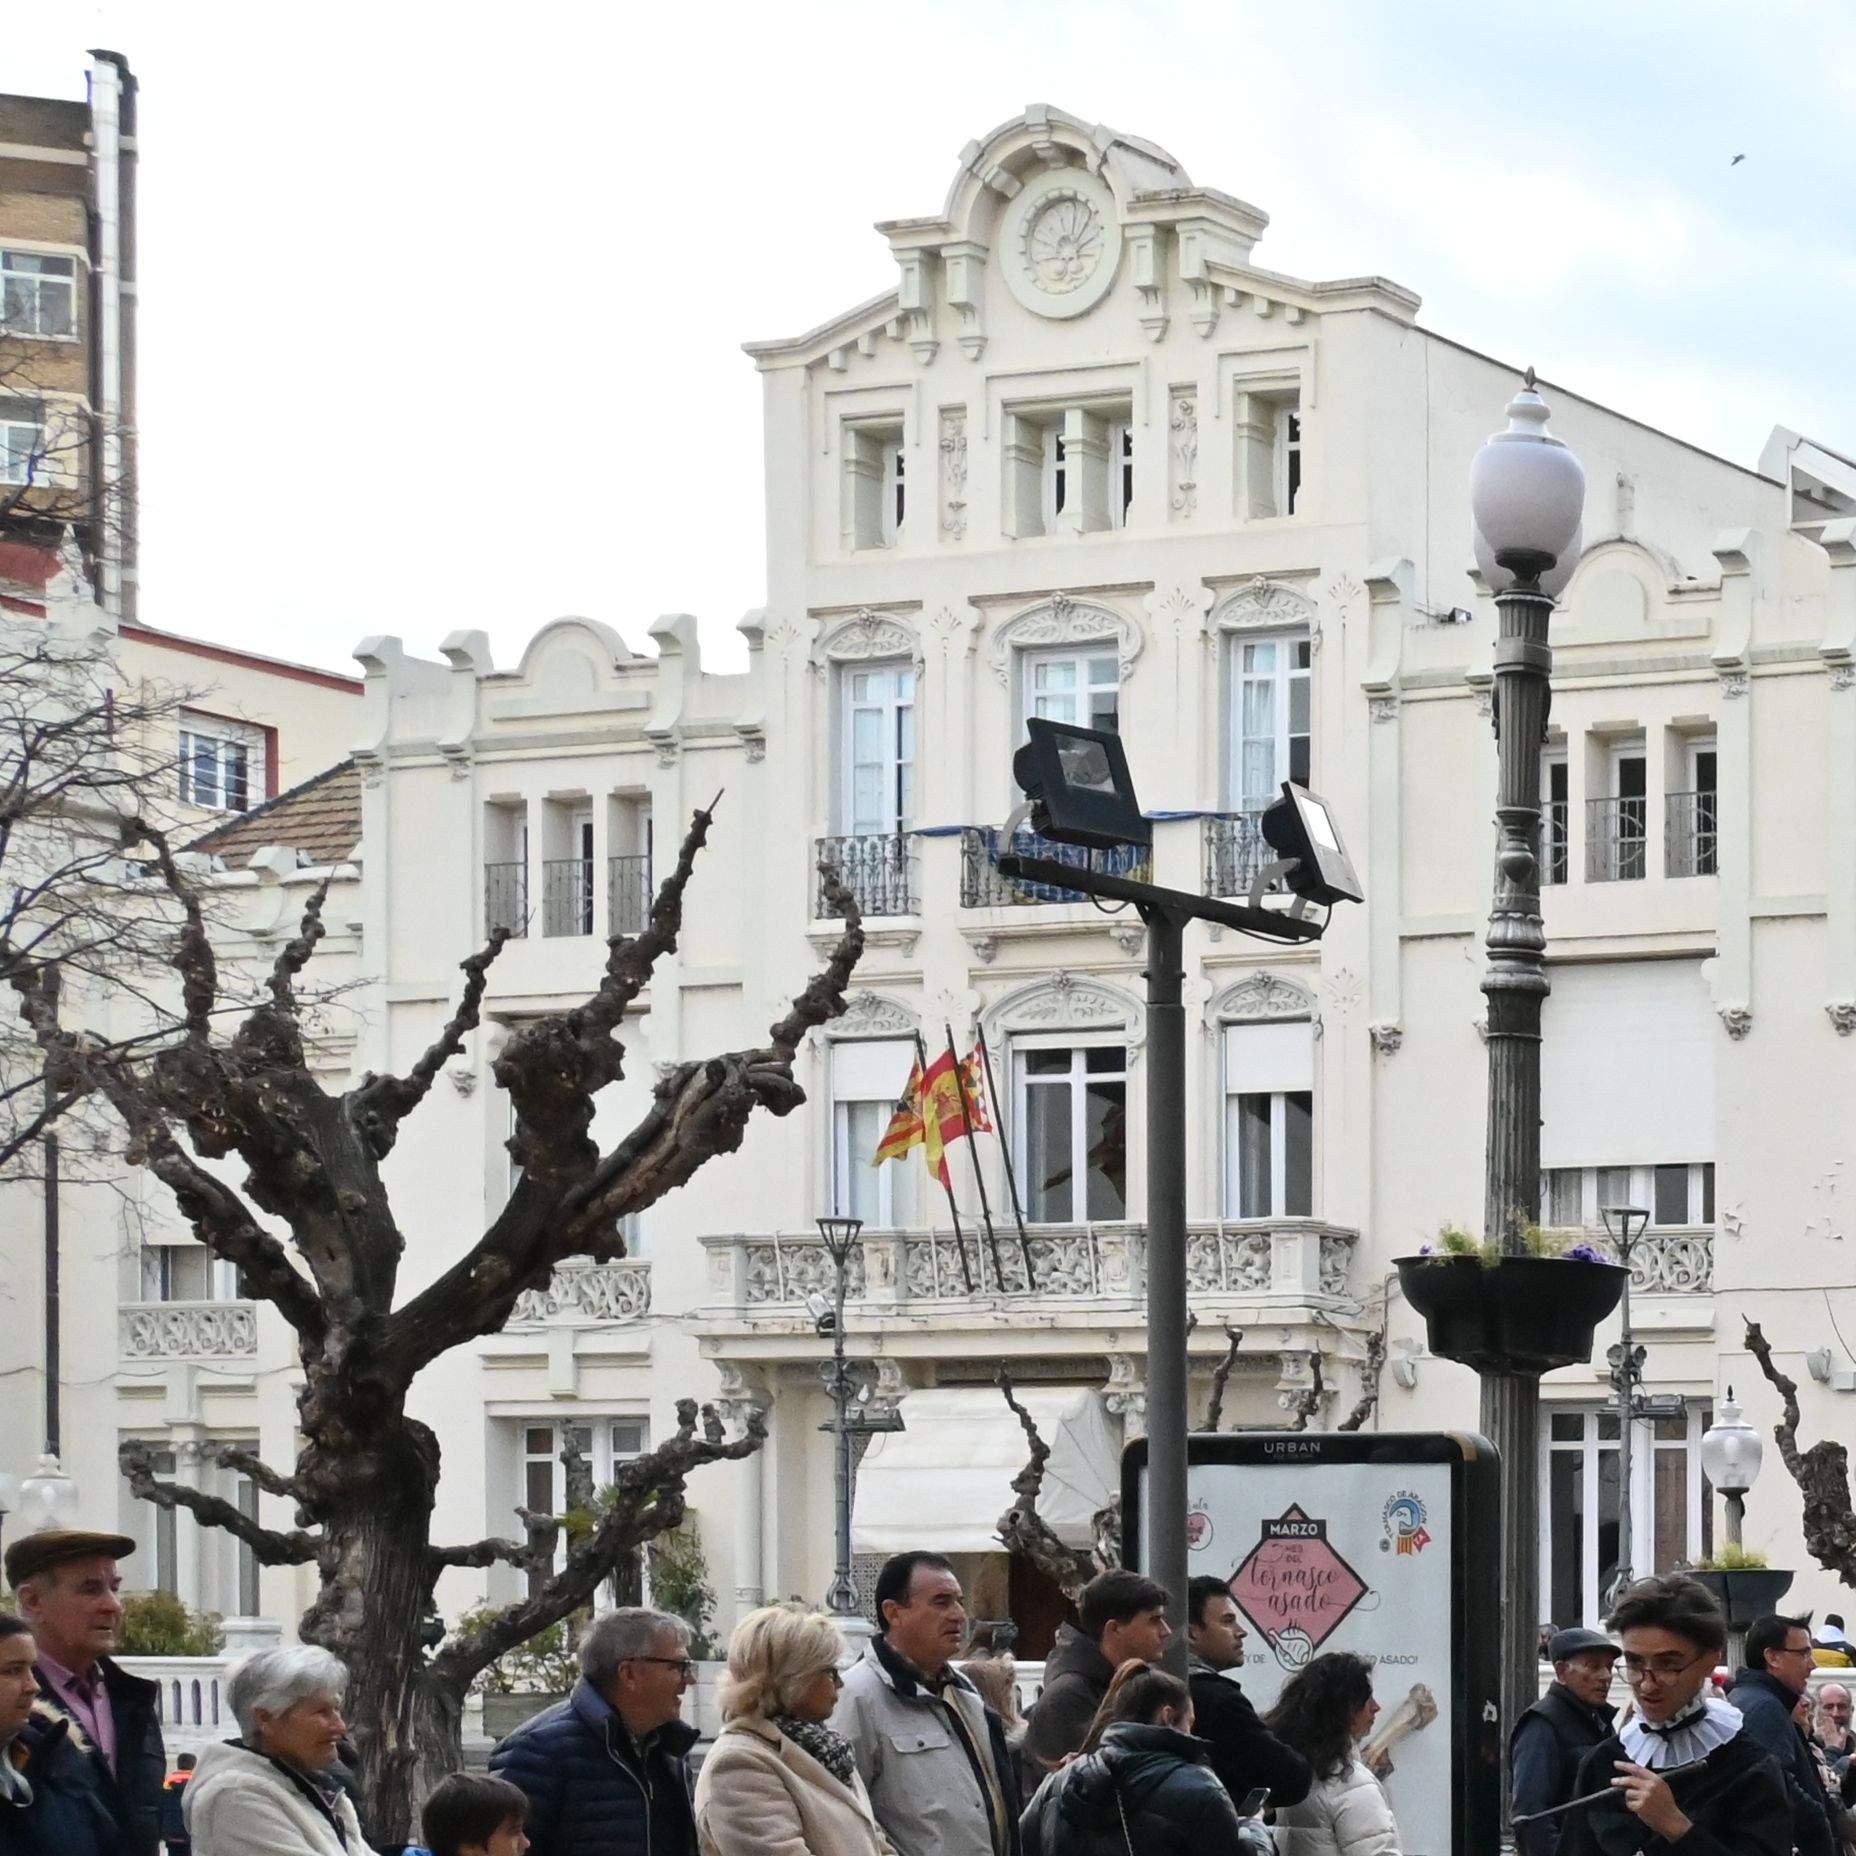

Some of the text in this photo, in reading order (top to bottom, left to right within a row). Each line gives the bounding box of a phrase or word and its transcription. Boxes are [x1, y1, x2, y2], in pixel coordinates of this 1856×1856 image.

[1264, 1442, 1321, 1453] URBAN
[1270, 1523, 1318, 1536] MARZO
[1268, 1585, 1329, 1616] asado
[1379, 1654, 1418, 1665] ASADO!
